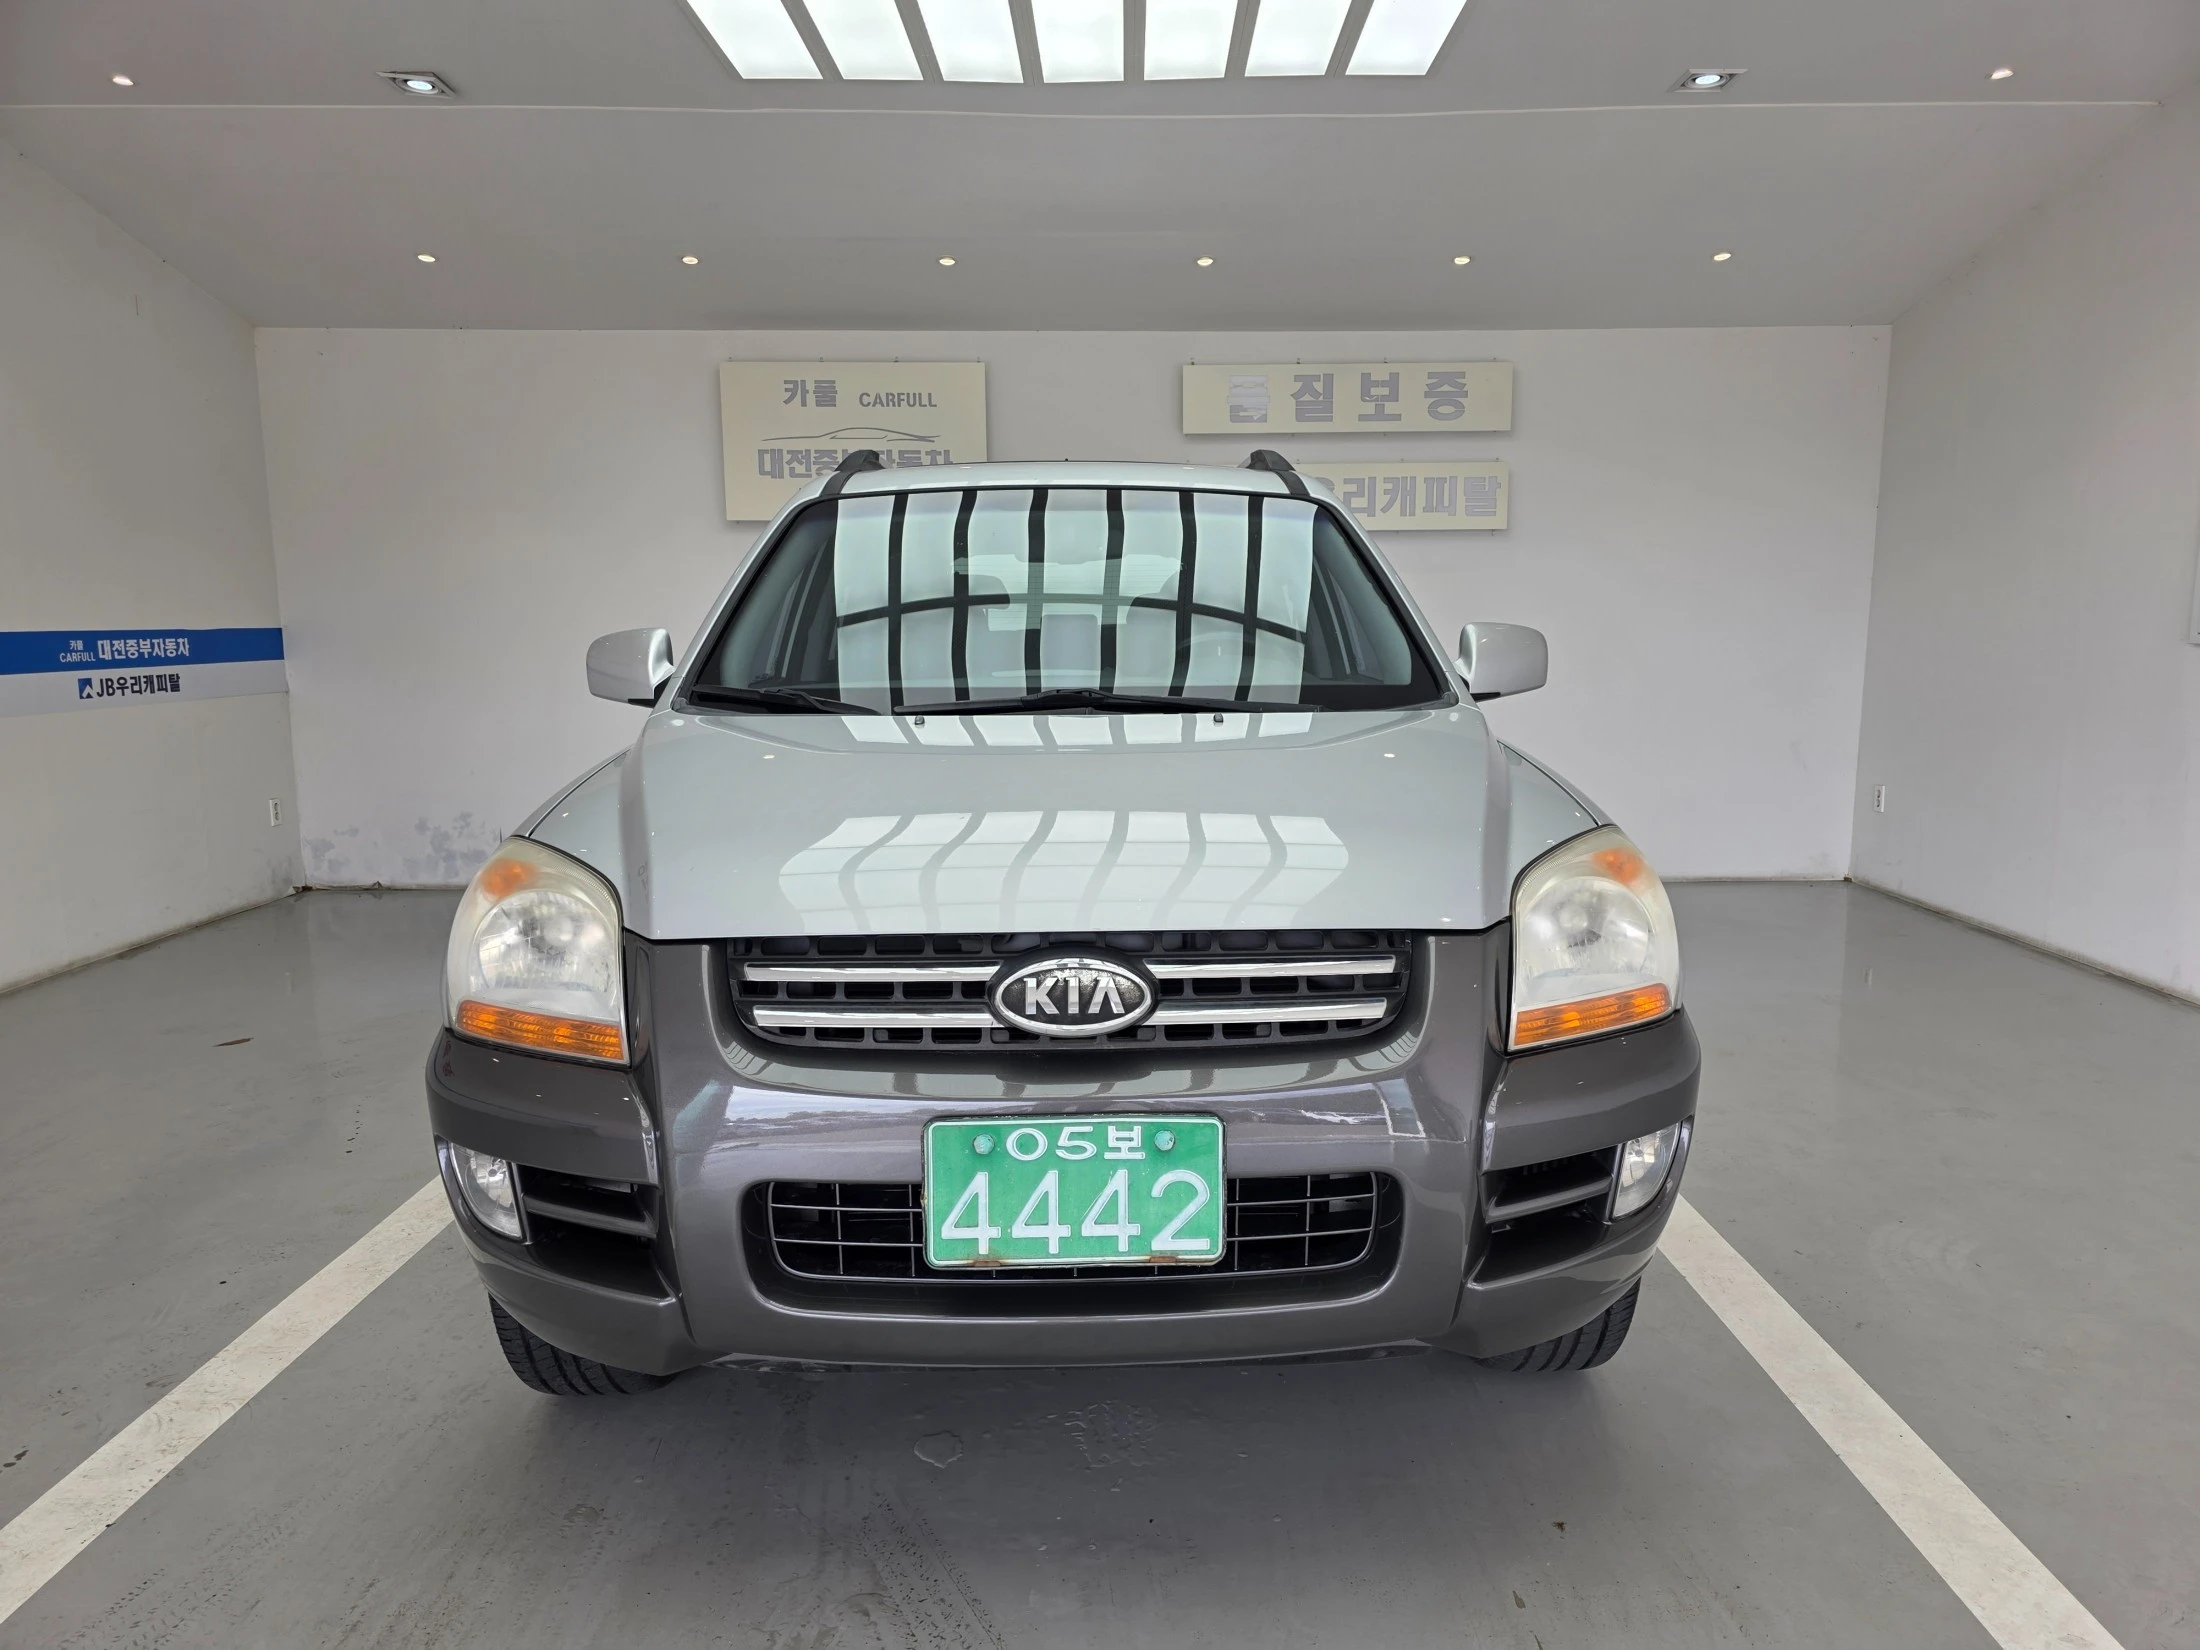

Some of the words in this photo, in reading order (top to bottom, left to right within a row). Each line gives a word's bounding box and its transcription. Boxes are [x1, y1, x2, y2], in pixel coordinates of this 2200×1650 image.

[859, 392, 937, 407] CARFULL
[1315, 476, 1501, 517] 리캐피탈
[60, 652, 96, 662] CARFULL
[97, 637, 190, 660] 대전중부자동차
[96, 673, 180, 697] JB우리캐피탈
[1024, 977, 1126, 1015] KIA
[1006, 1125, 1146, 1161] 05보
[941, 1169, 1210, 1255] 4442
